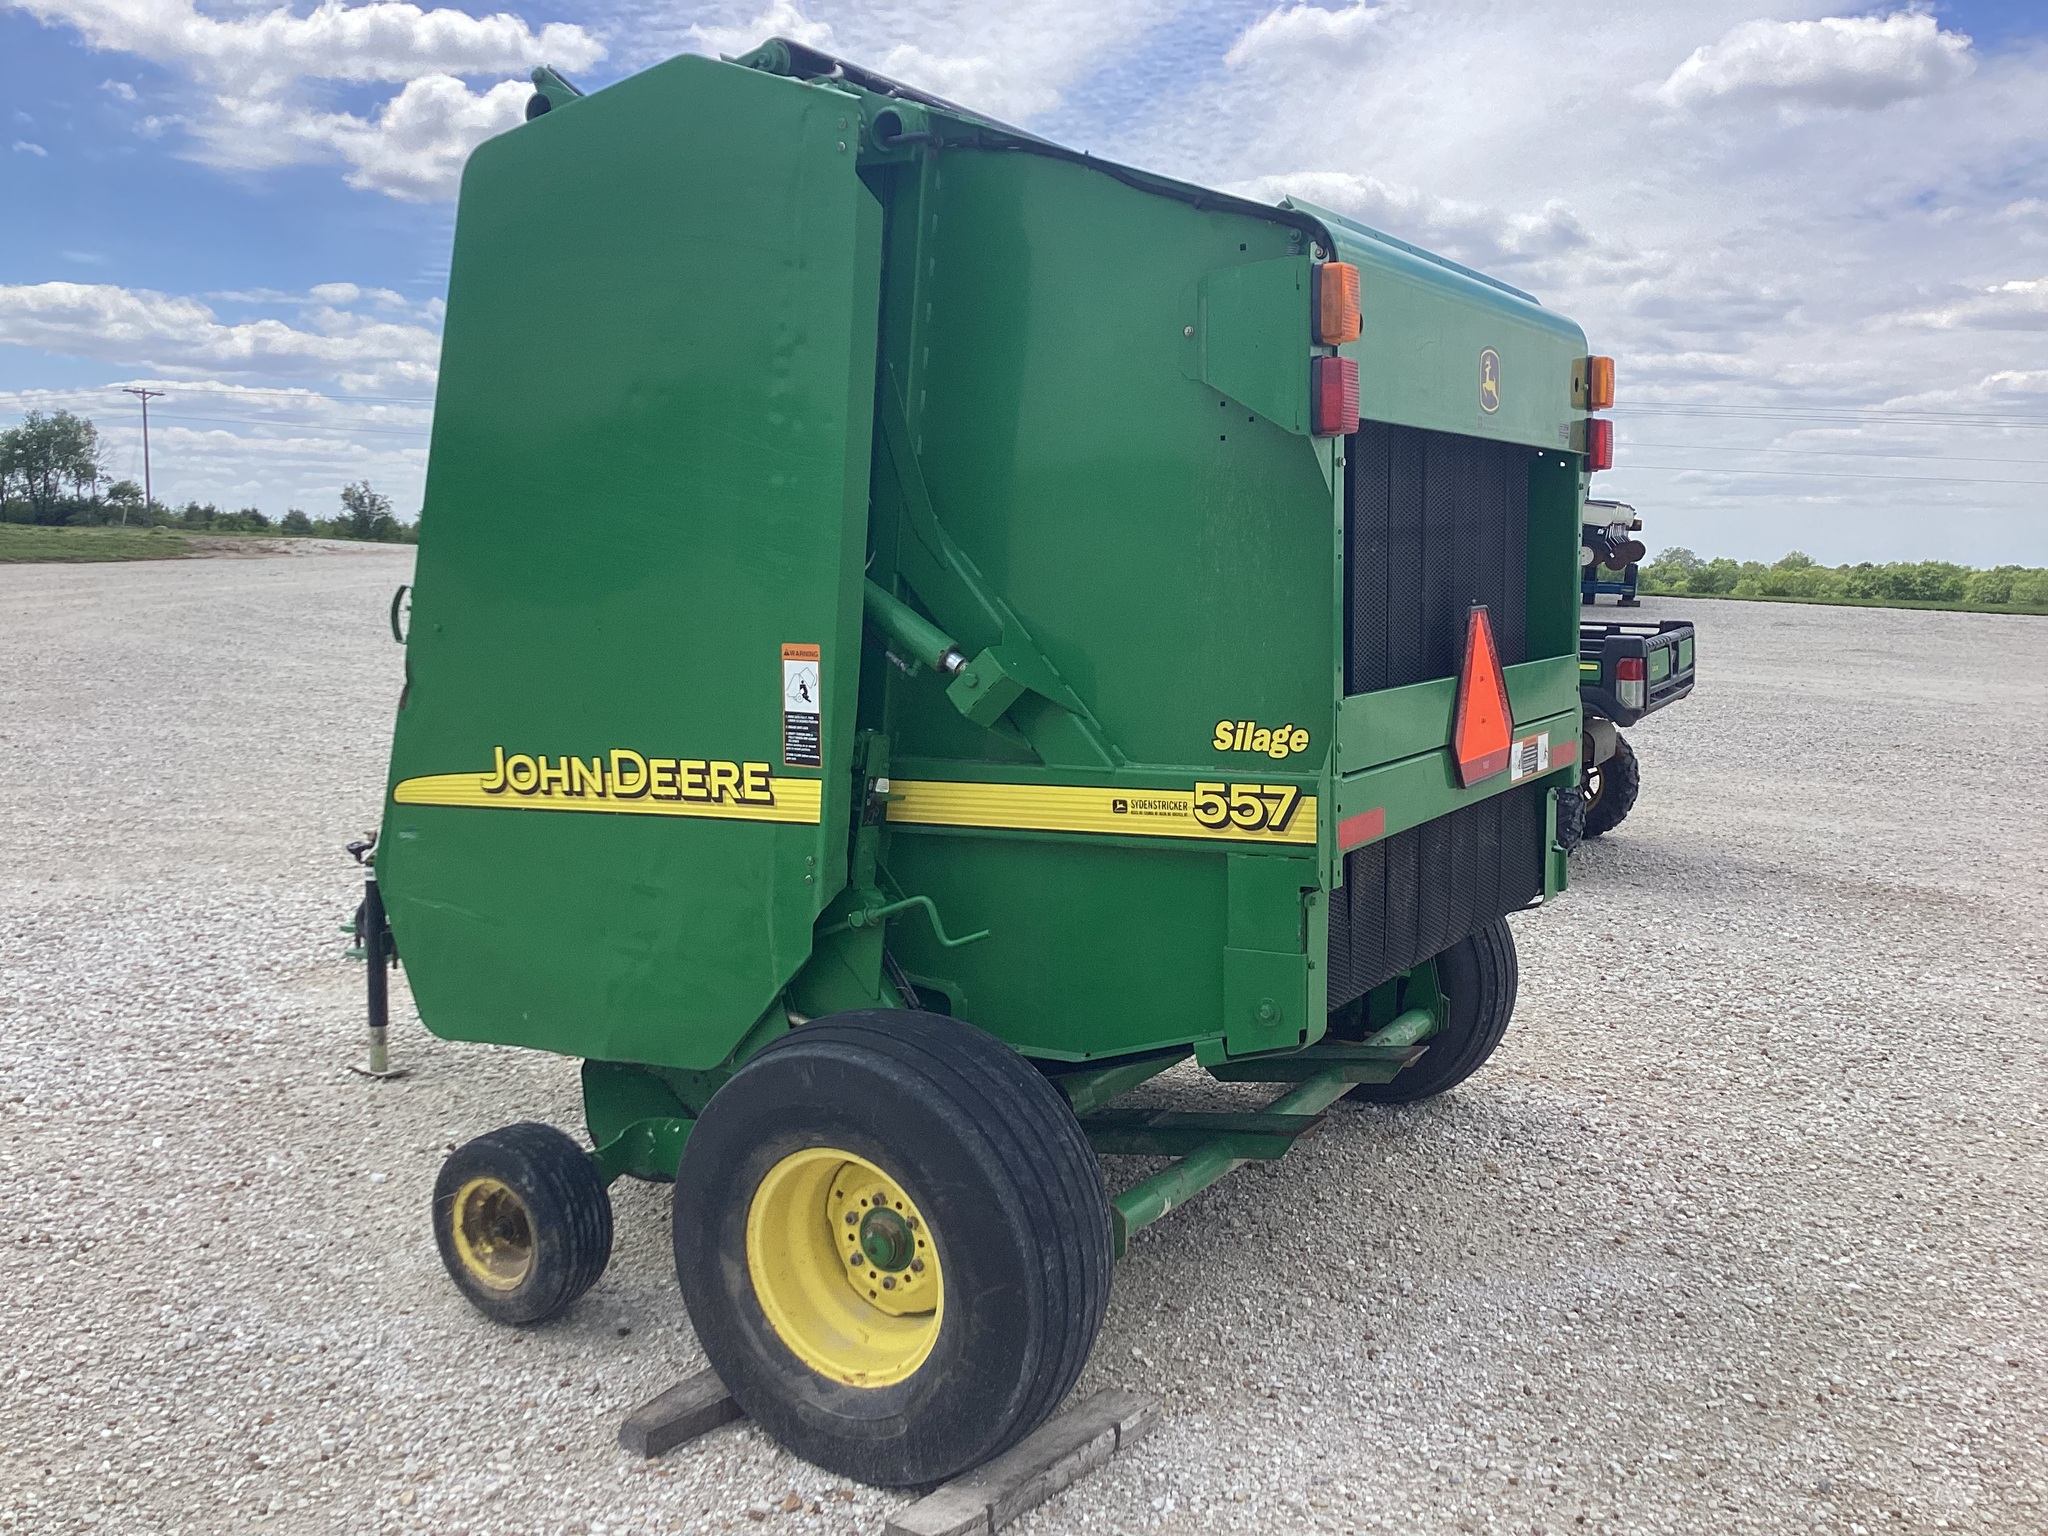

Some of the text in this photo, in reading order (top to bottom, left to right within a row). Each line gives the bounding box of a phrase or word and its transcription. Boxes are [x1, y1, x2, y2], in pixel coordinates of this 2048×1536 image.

[1212, 719, 1310, 760] Silage
[481, 746, 775, 806] JOHN DEERE
[1131, 799, 1188, 811] SYDENSTRICKER
[1193, 781, 1303, 833] 557
